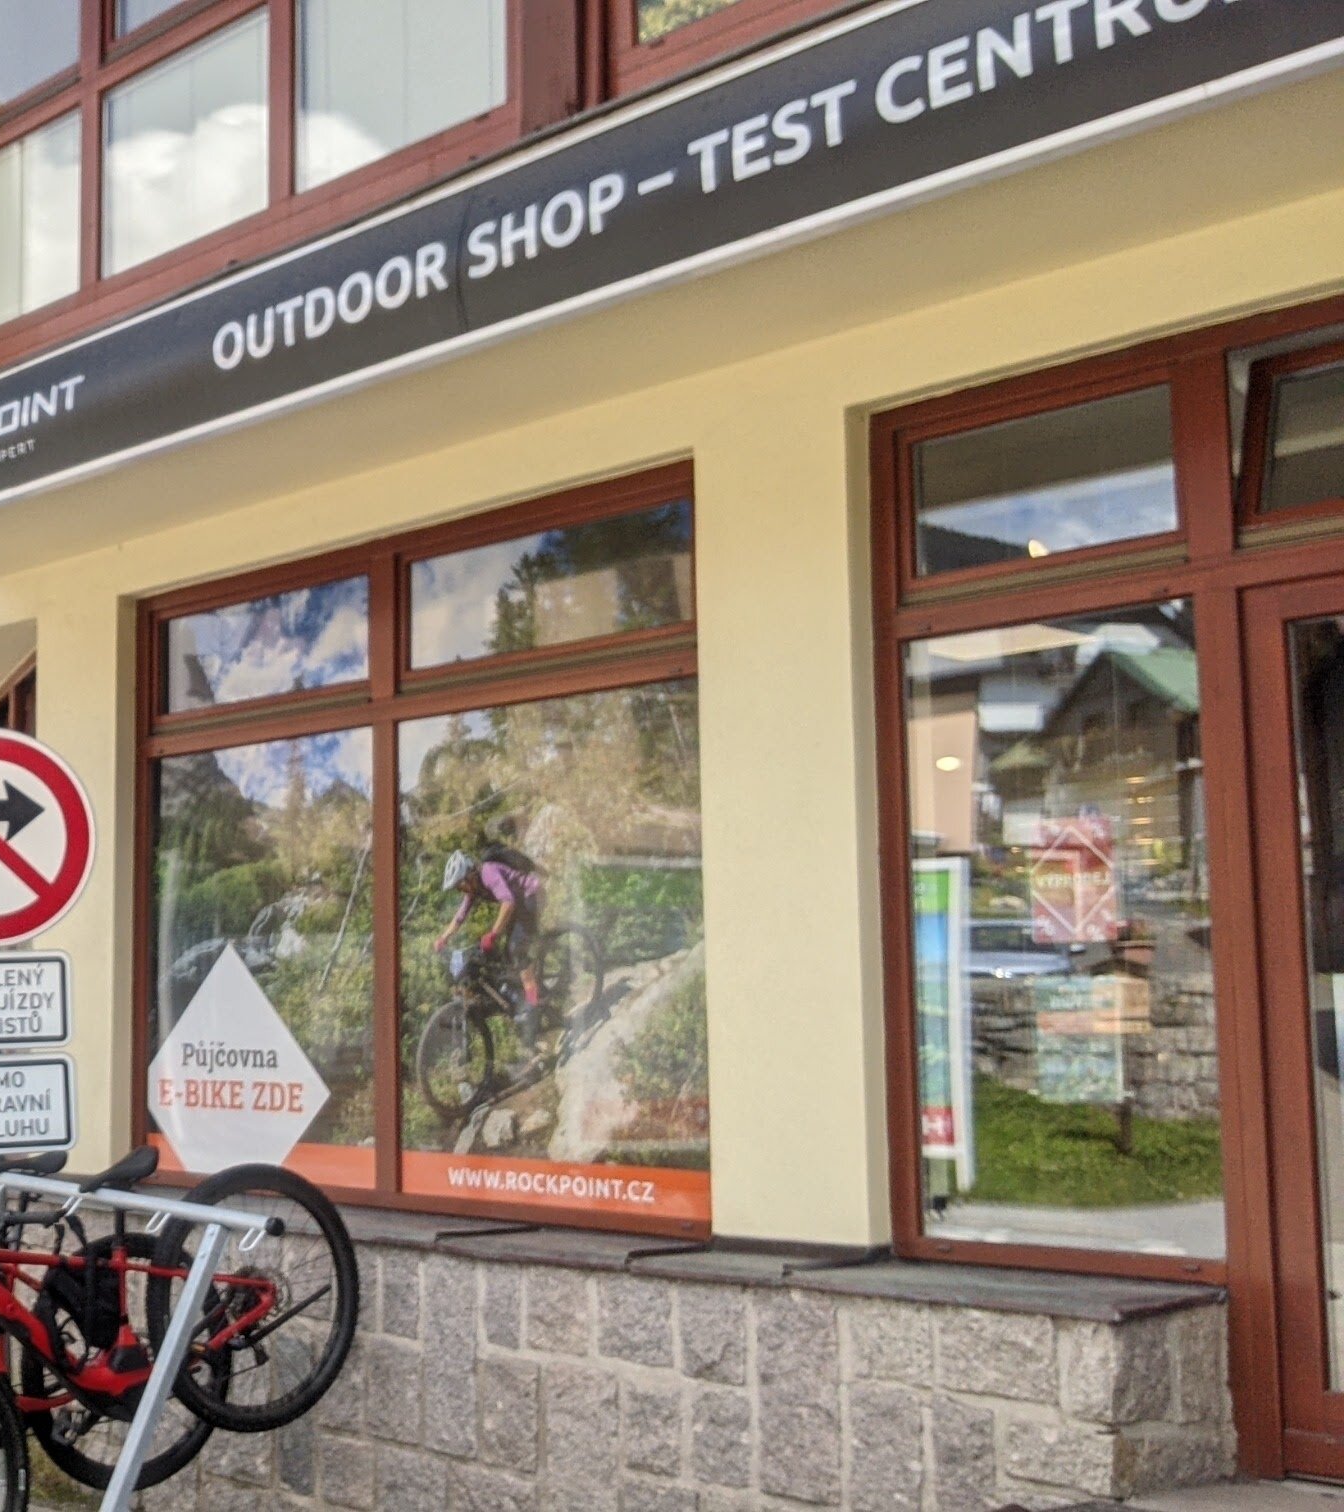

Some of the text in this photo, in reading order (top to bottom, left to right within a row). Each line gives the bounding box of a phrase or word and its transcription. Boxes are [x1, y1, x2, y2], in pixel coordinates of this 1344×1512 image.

[212, 241, 449, 370] OUTDOOR
[467, 172, 626, 279] SHOP
[687, 79, 856, 194] TEST
[875, 0, 1239, 124] CENTR
[0, 989, 55, 1011] JÍZDY
[181, 1040, 279, 1073] Půjčovna
[159, 1079, 304, 1113] E-BIKE ZDE
[448, 1167, 656, 1202] WWW.ROCKPOINT.CZ
